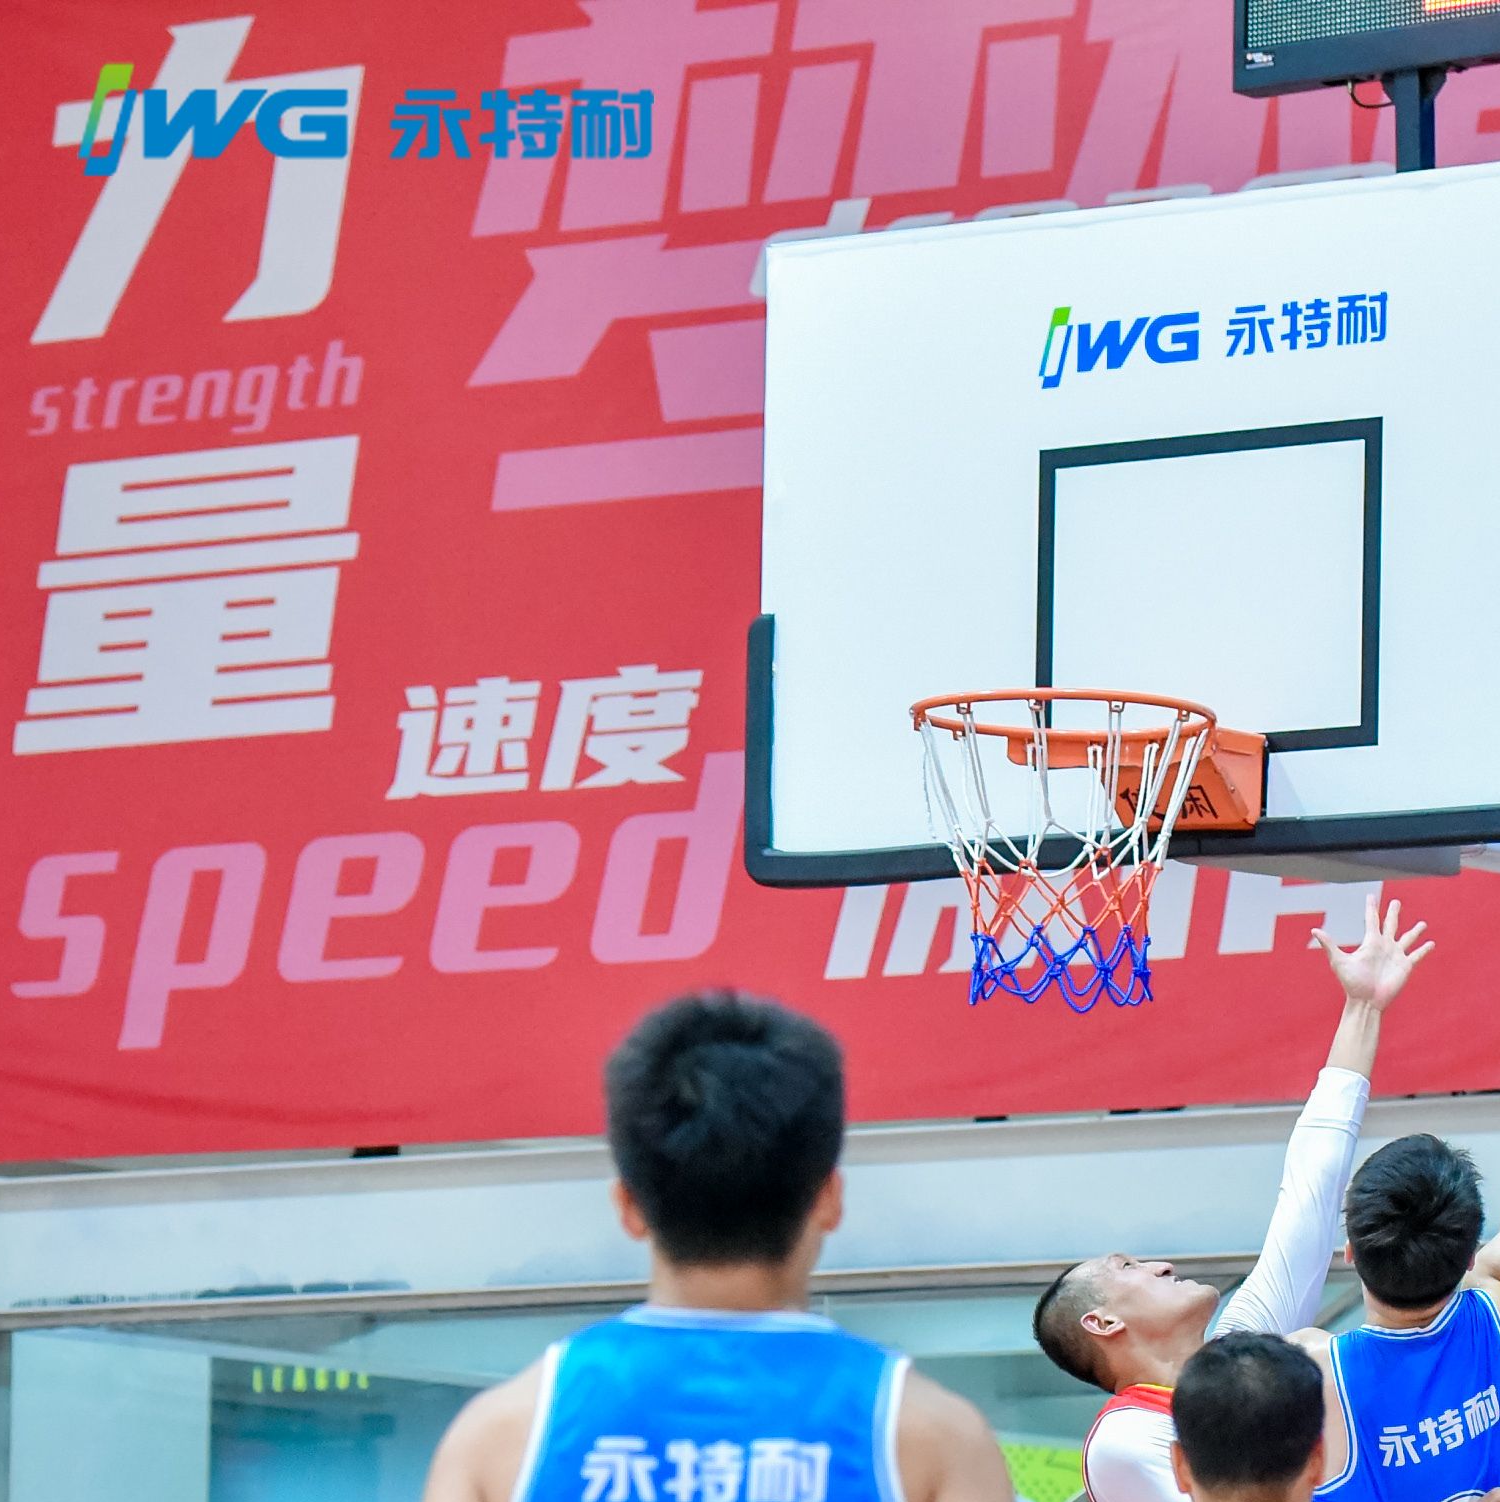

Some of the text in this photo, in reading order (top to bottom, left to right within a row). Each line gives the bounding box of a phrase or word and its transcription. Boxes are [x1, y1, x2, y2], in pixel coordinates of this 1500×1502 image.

[1225, 291, 1388, 358] 永特耐
[28, 339, 364, 436] strength
[384, 663, 704, 800] 速度
[10, 750, 747, 1052] speed
[1379, 1383, 1500, 1469] 永特耐
